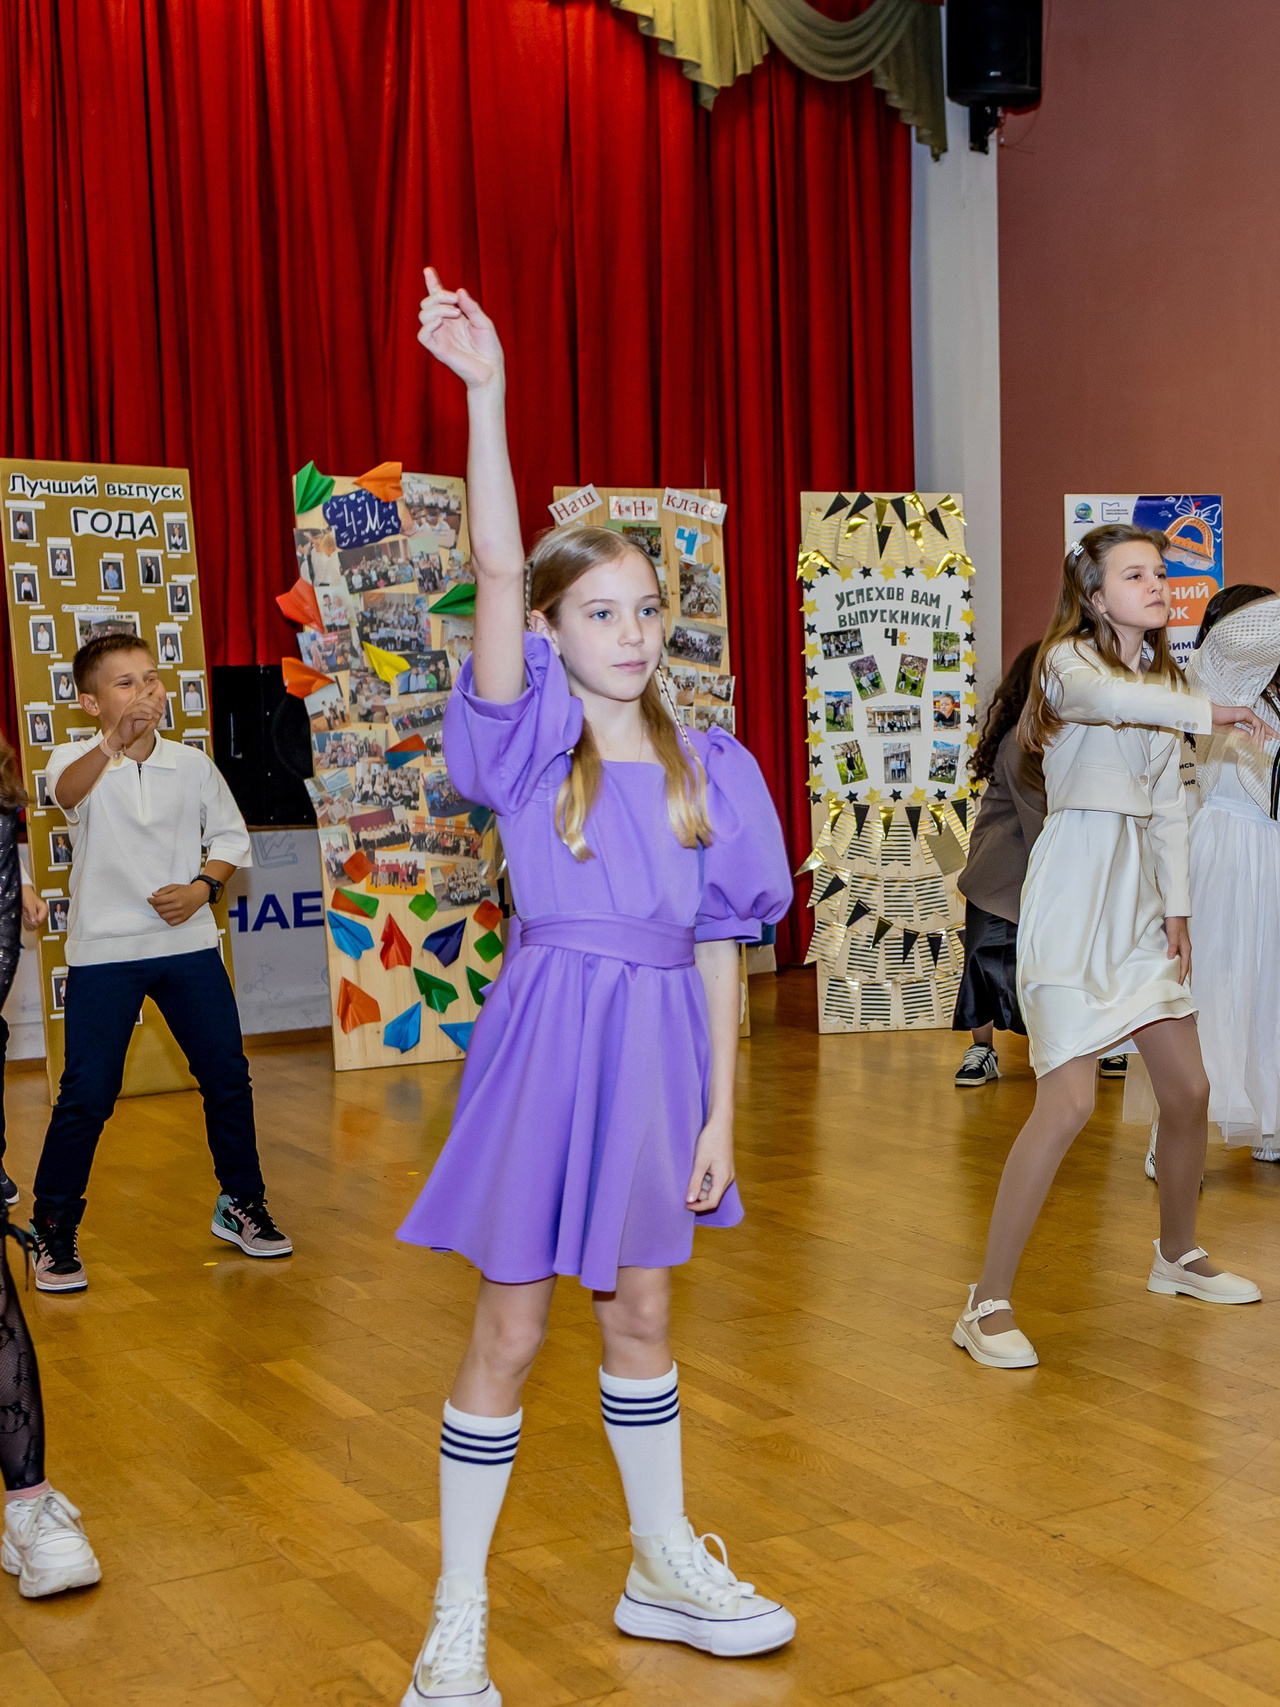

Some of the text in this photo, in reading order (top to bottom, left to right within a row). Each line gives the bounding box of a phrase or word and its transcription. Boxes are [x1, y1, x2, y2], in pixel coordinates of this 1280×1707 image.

[11, 475, 183, 503] Лучший выпуск
[553, 491, 596, 520] Наш
[666, 494, 720, 519] класс
[73, 510, 157, 539] ГОДА
[835, 586, 941, 611] УСПЕХОВ ВАМ
